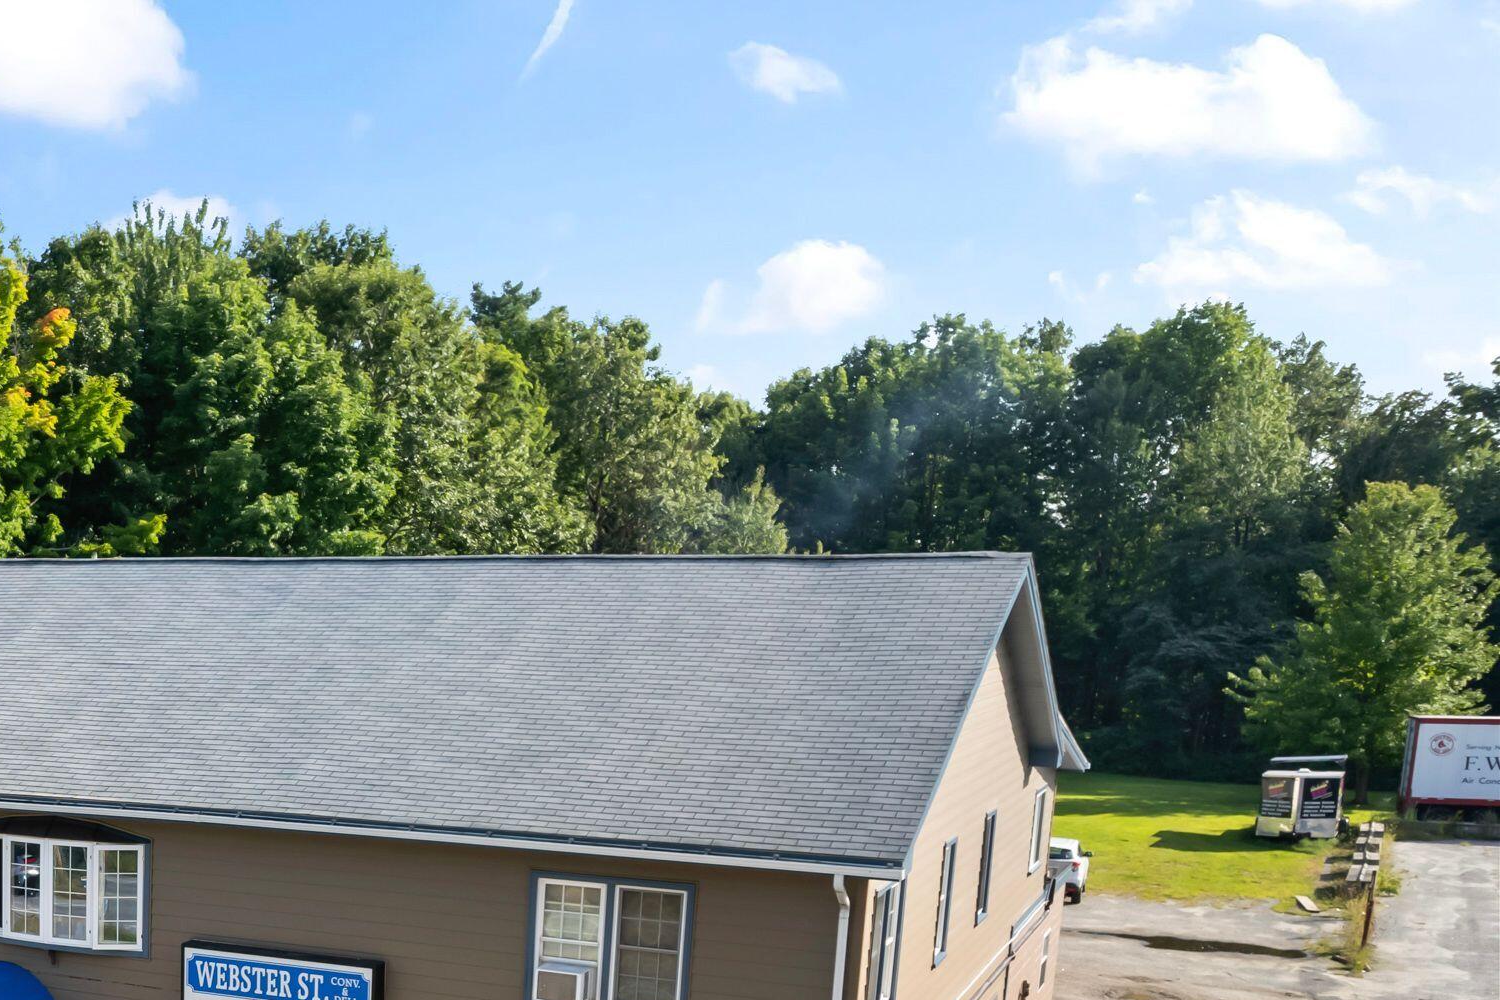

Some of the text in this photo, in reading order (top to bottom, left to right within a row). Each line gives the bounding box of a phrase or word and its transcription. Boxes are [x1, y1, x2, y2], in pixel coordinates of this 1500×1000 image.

[195, 960, 292, 998] WEBSTER
[331, 976, 361, 989] CONV.
[342, 987, 349, 997] &
